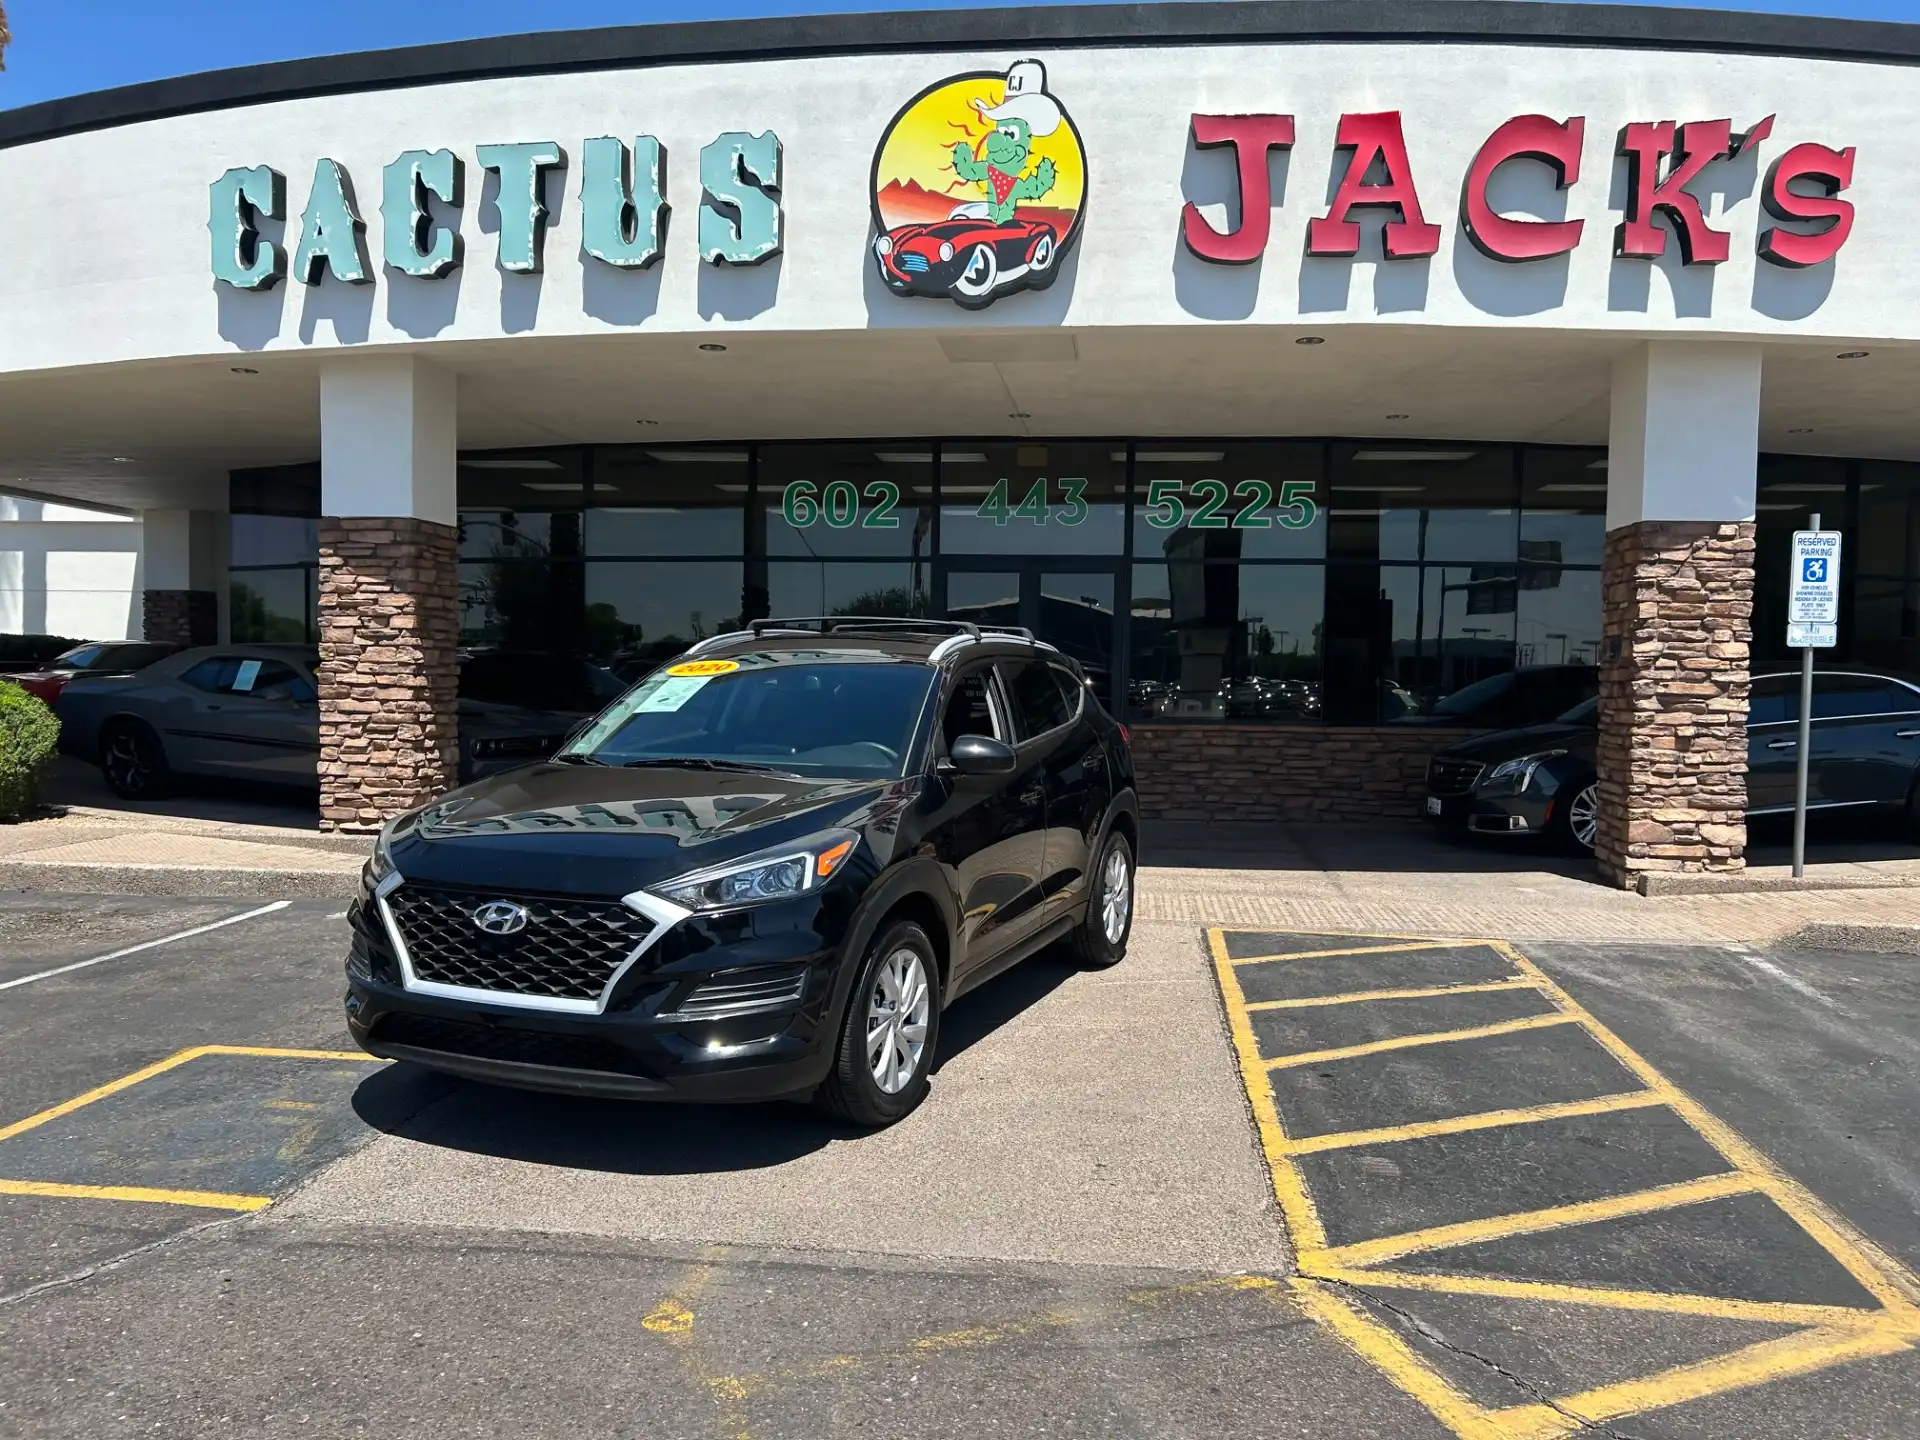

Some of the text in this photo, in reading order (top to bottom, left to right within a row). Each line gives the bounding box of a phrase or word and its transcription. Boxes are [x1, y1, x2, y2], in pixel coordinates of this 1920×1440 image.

[1008, 75, 1024, 92] CJ
[207, 130, 784, 291] CACTUS
[782, 477, 1318, 530] 602 443 5225
[1797, 537, 1837, 546] RESERVED
[1800, 548, 1832, 556] PARKING
[673, 662, 734, 673] 2020
